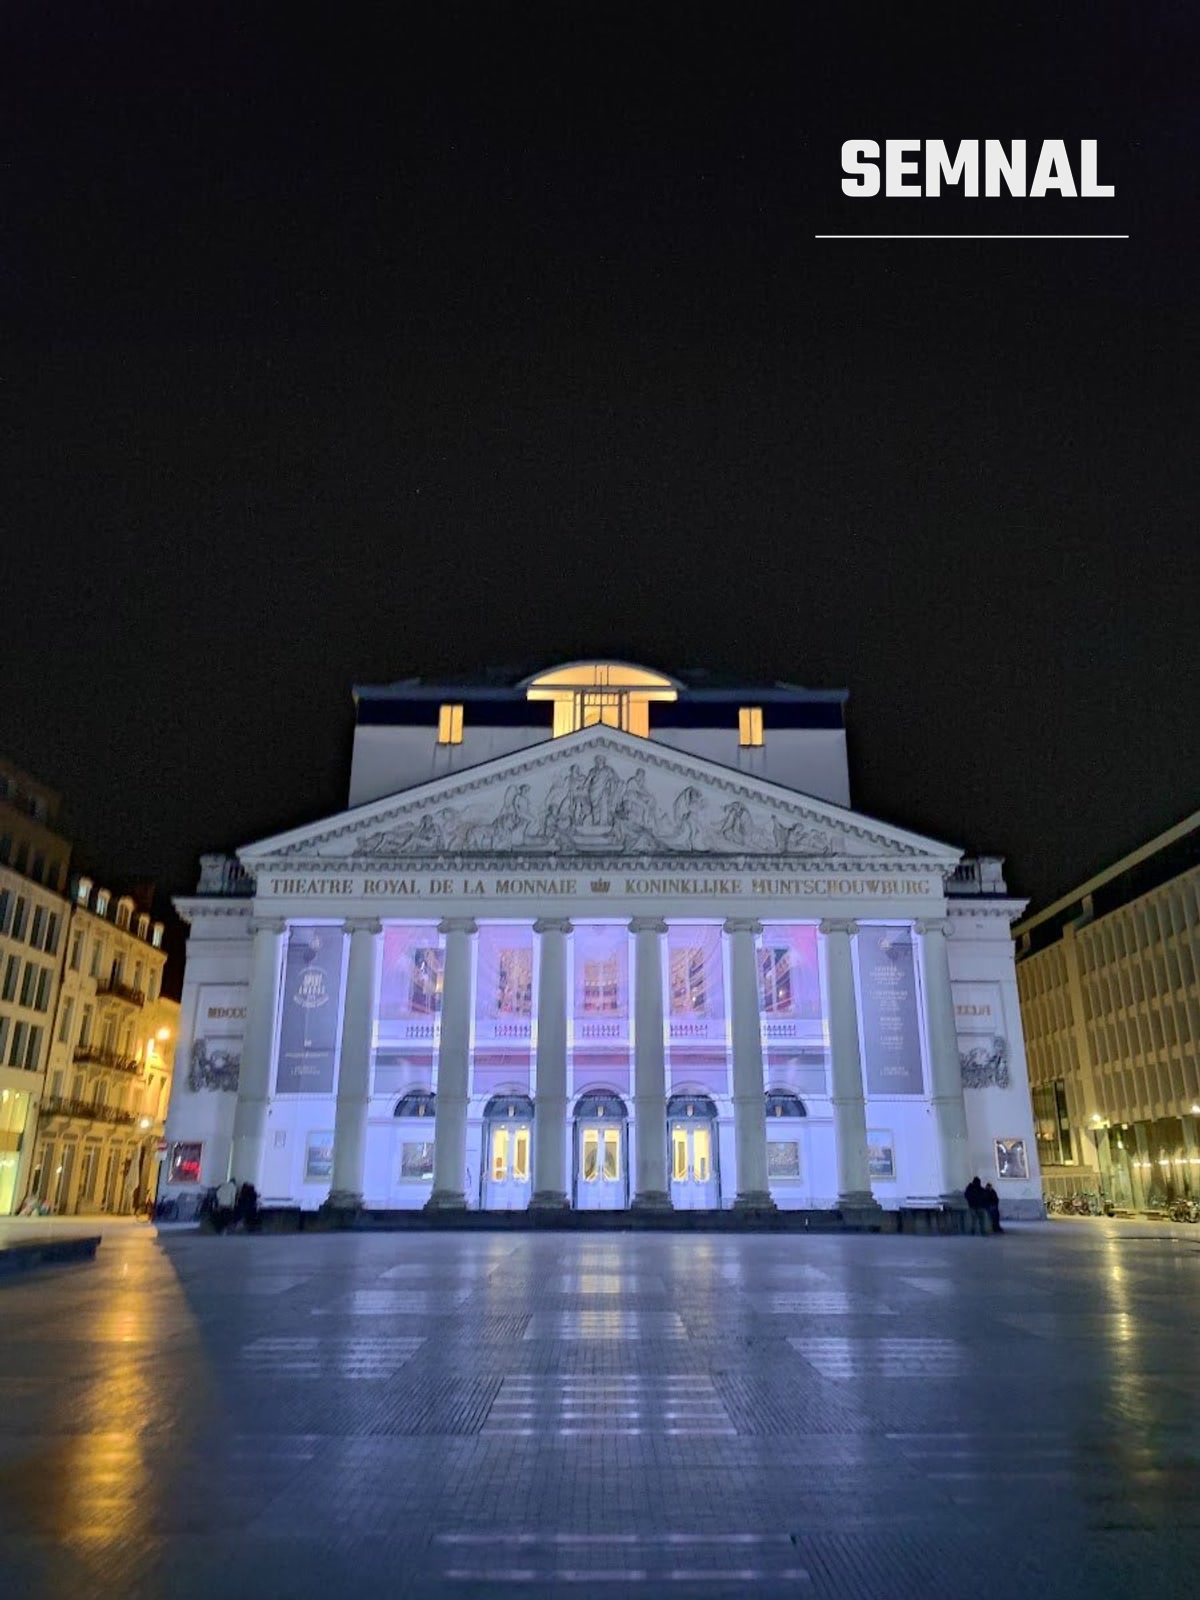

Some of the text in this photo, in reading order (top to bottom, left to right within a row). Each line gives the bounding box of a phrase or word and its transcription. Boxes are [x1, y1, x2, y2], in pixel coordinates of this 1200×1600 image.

[270, 878, 930, 896] THEATRE ROYAL DE LA MONNAIE KONINKLIJKE MUNTSCHOUWBURG
